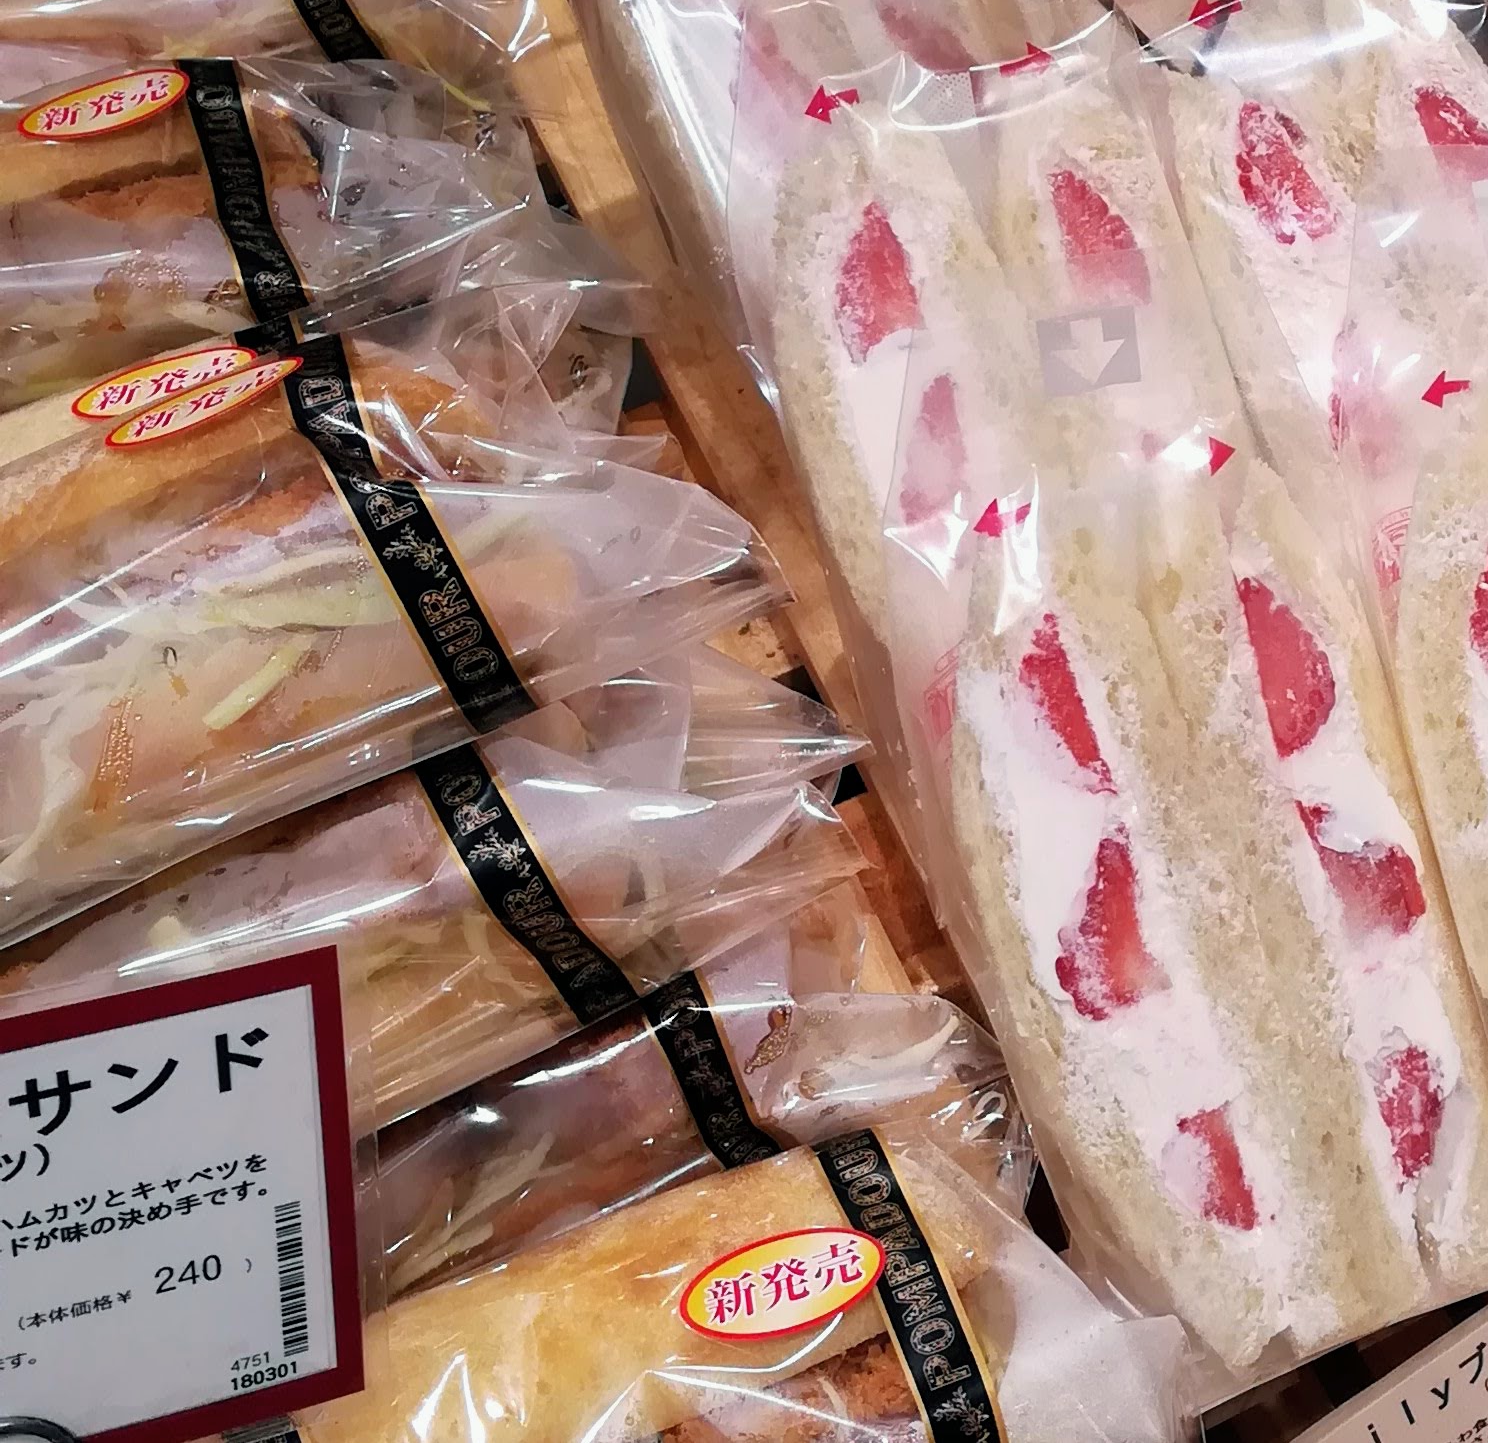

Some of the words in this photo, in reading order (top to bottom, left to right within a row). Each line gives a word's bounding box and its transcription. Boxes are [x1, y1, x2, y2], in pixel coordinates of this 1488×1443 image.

[40, 74, 170, 132] 新発売
[8, 1026, 270, 1136] サンド
[154, 1254, 223, 1295] 240
[706, 1239, 864, 1327] 新発売
[229, 1360, 299, 1391] 180301
[230, 1351, 272, 1372] 4751
